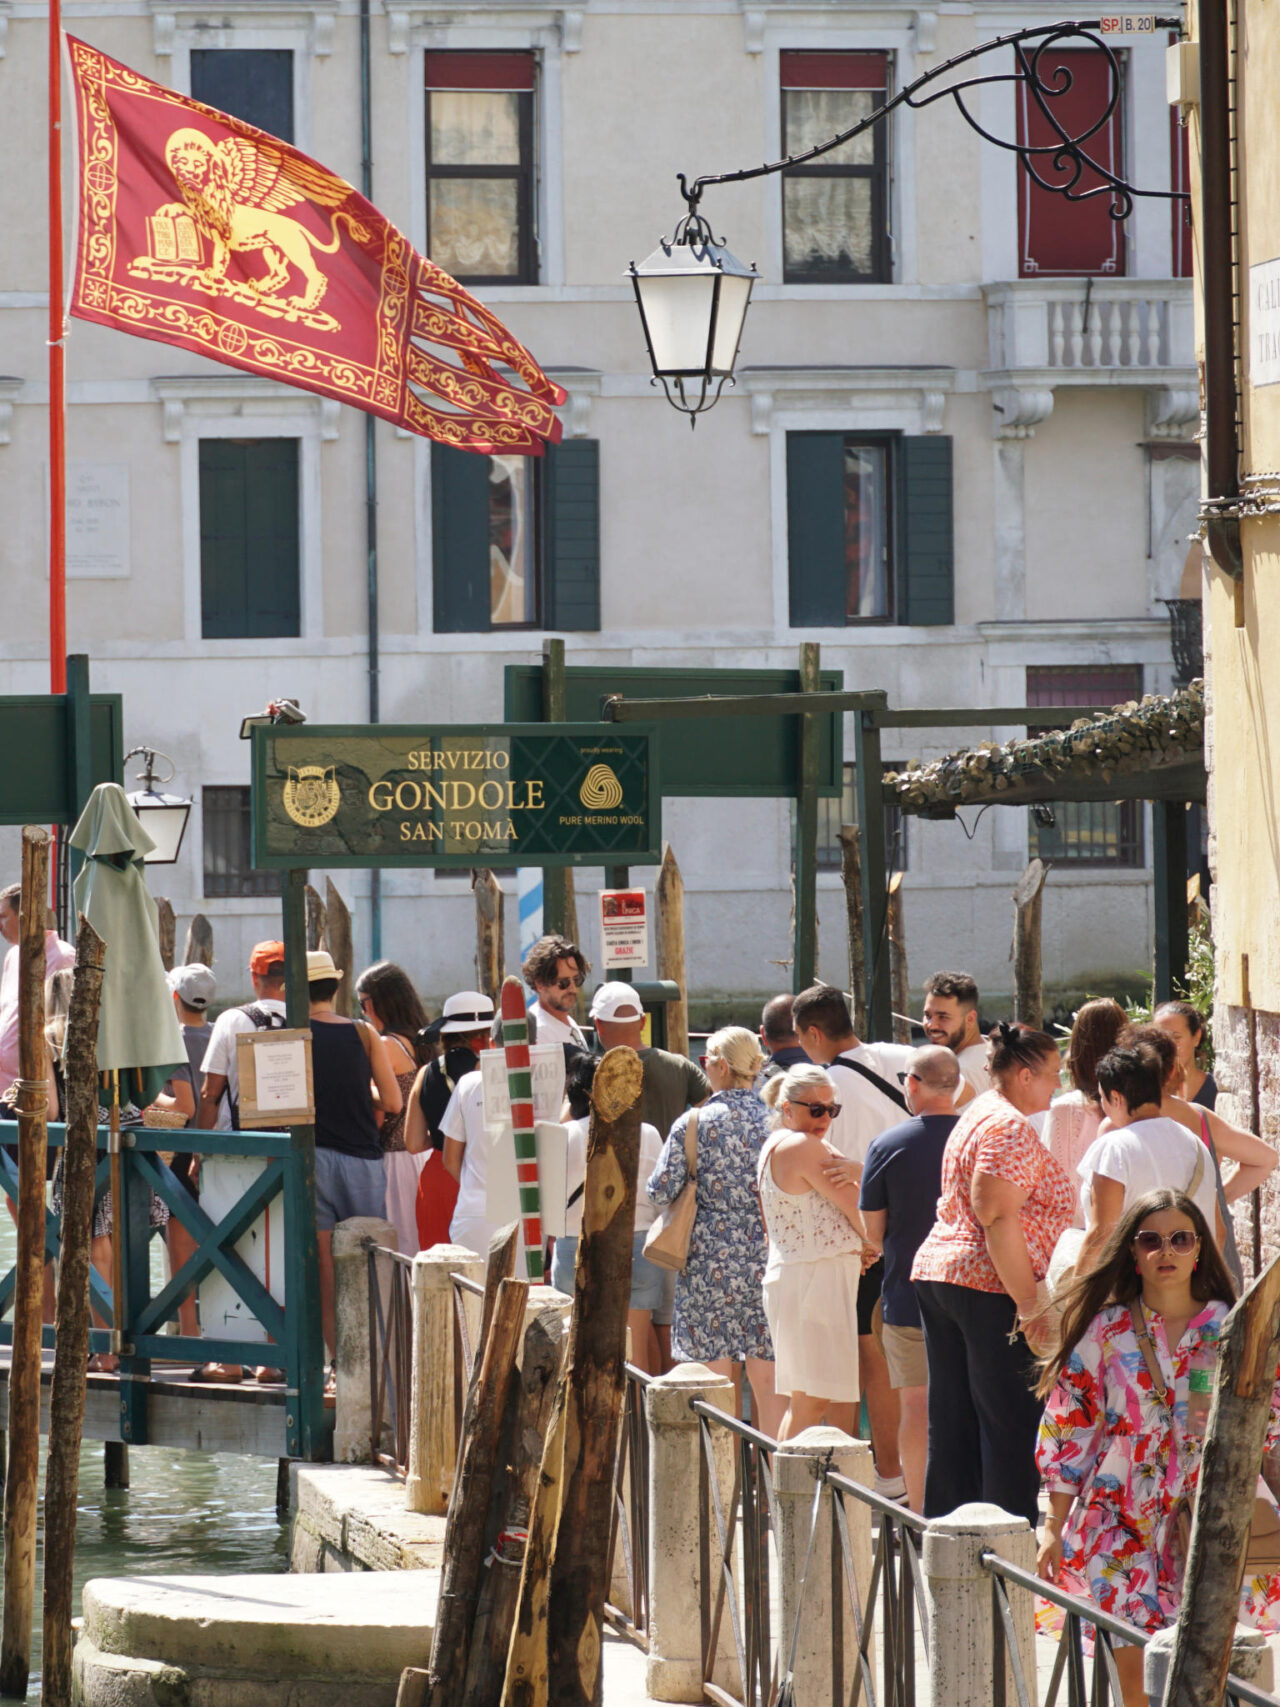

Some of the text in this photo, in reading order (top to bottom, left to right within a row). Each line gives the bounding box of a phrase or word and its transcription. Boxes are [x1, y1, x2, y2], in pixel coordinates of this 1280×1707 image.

[1102, 17, 1151, 32] SP. B. 20
[408, 751, 510, 770] SERVIZIO
[368, 781, 545, 811] GONDOLE
[400, 818, 519, 841] SAN TOMÀ
[559, 815, 644, 825] PURE MERINO WOOL
